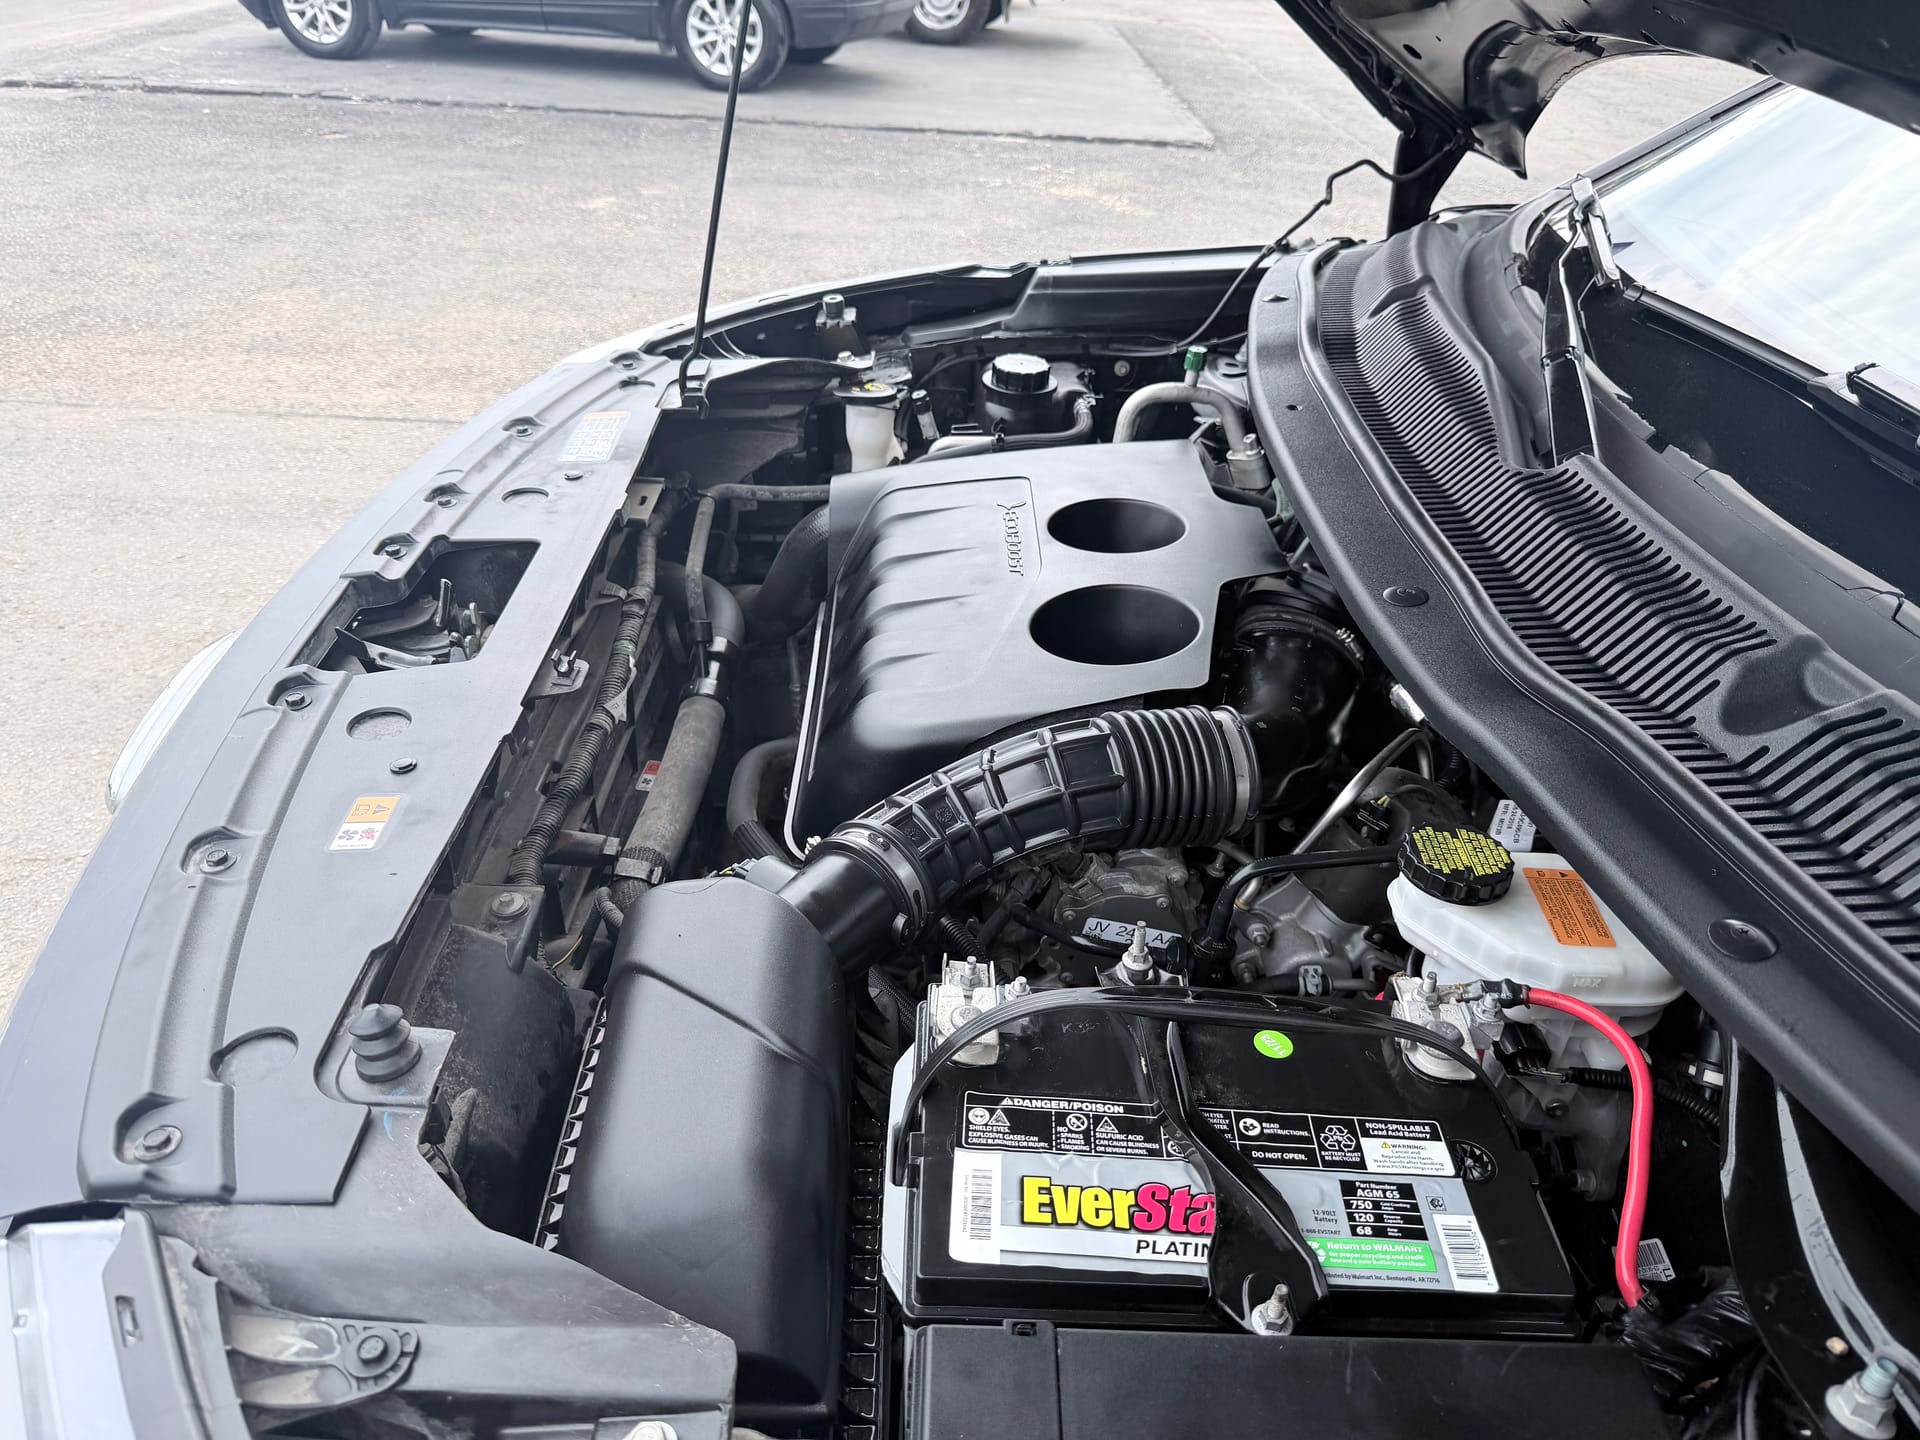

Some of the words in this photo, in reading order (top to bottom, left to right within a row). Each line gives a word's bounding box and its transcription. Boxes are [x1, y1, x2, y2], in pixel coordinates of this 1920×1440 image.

[1003, 511, 1024, 577] ECOBOOST
[1088, 921, 1111, 933] JV
[1260, 1034, 1287, 1056] 11/23
[1014, 1098, 1124, 1114] DANGER/POISON
[1365, 1122, 1431, 1132] NON-SPILLABLE
[1095, 1132, 1127, 1140] SULFURIC
[1263, 1129, 1311, 1137] INSTRUCTIONS.
[987, 1138, 1018, 1146] BLINDNESS
[1127, 1141, 1160, 1149] BLINDNESS
[1390, 1143, 1427, 1151] WARNING:
[1356, 1189, 1383, 1198] AGM
[1385, 1190, 1400, 1199] 65
[1350, 1200, 1373, 1209] 750
[1314, 1216, 1338, 1224] Battery
[1353, 1213, 1374, 1222] 120
[1356, 1226, 1373, 1235] 68
[1327, 1242, 1359, 1250] Return
[1373, 1243, 1423, 1252] WALMART
[1364, 1252, 1391, 1260] recycling
